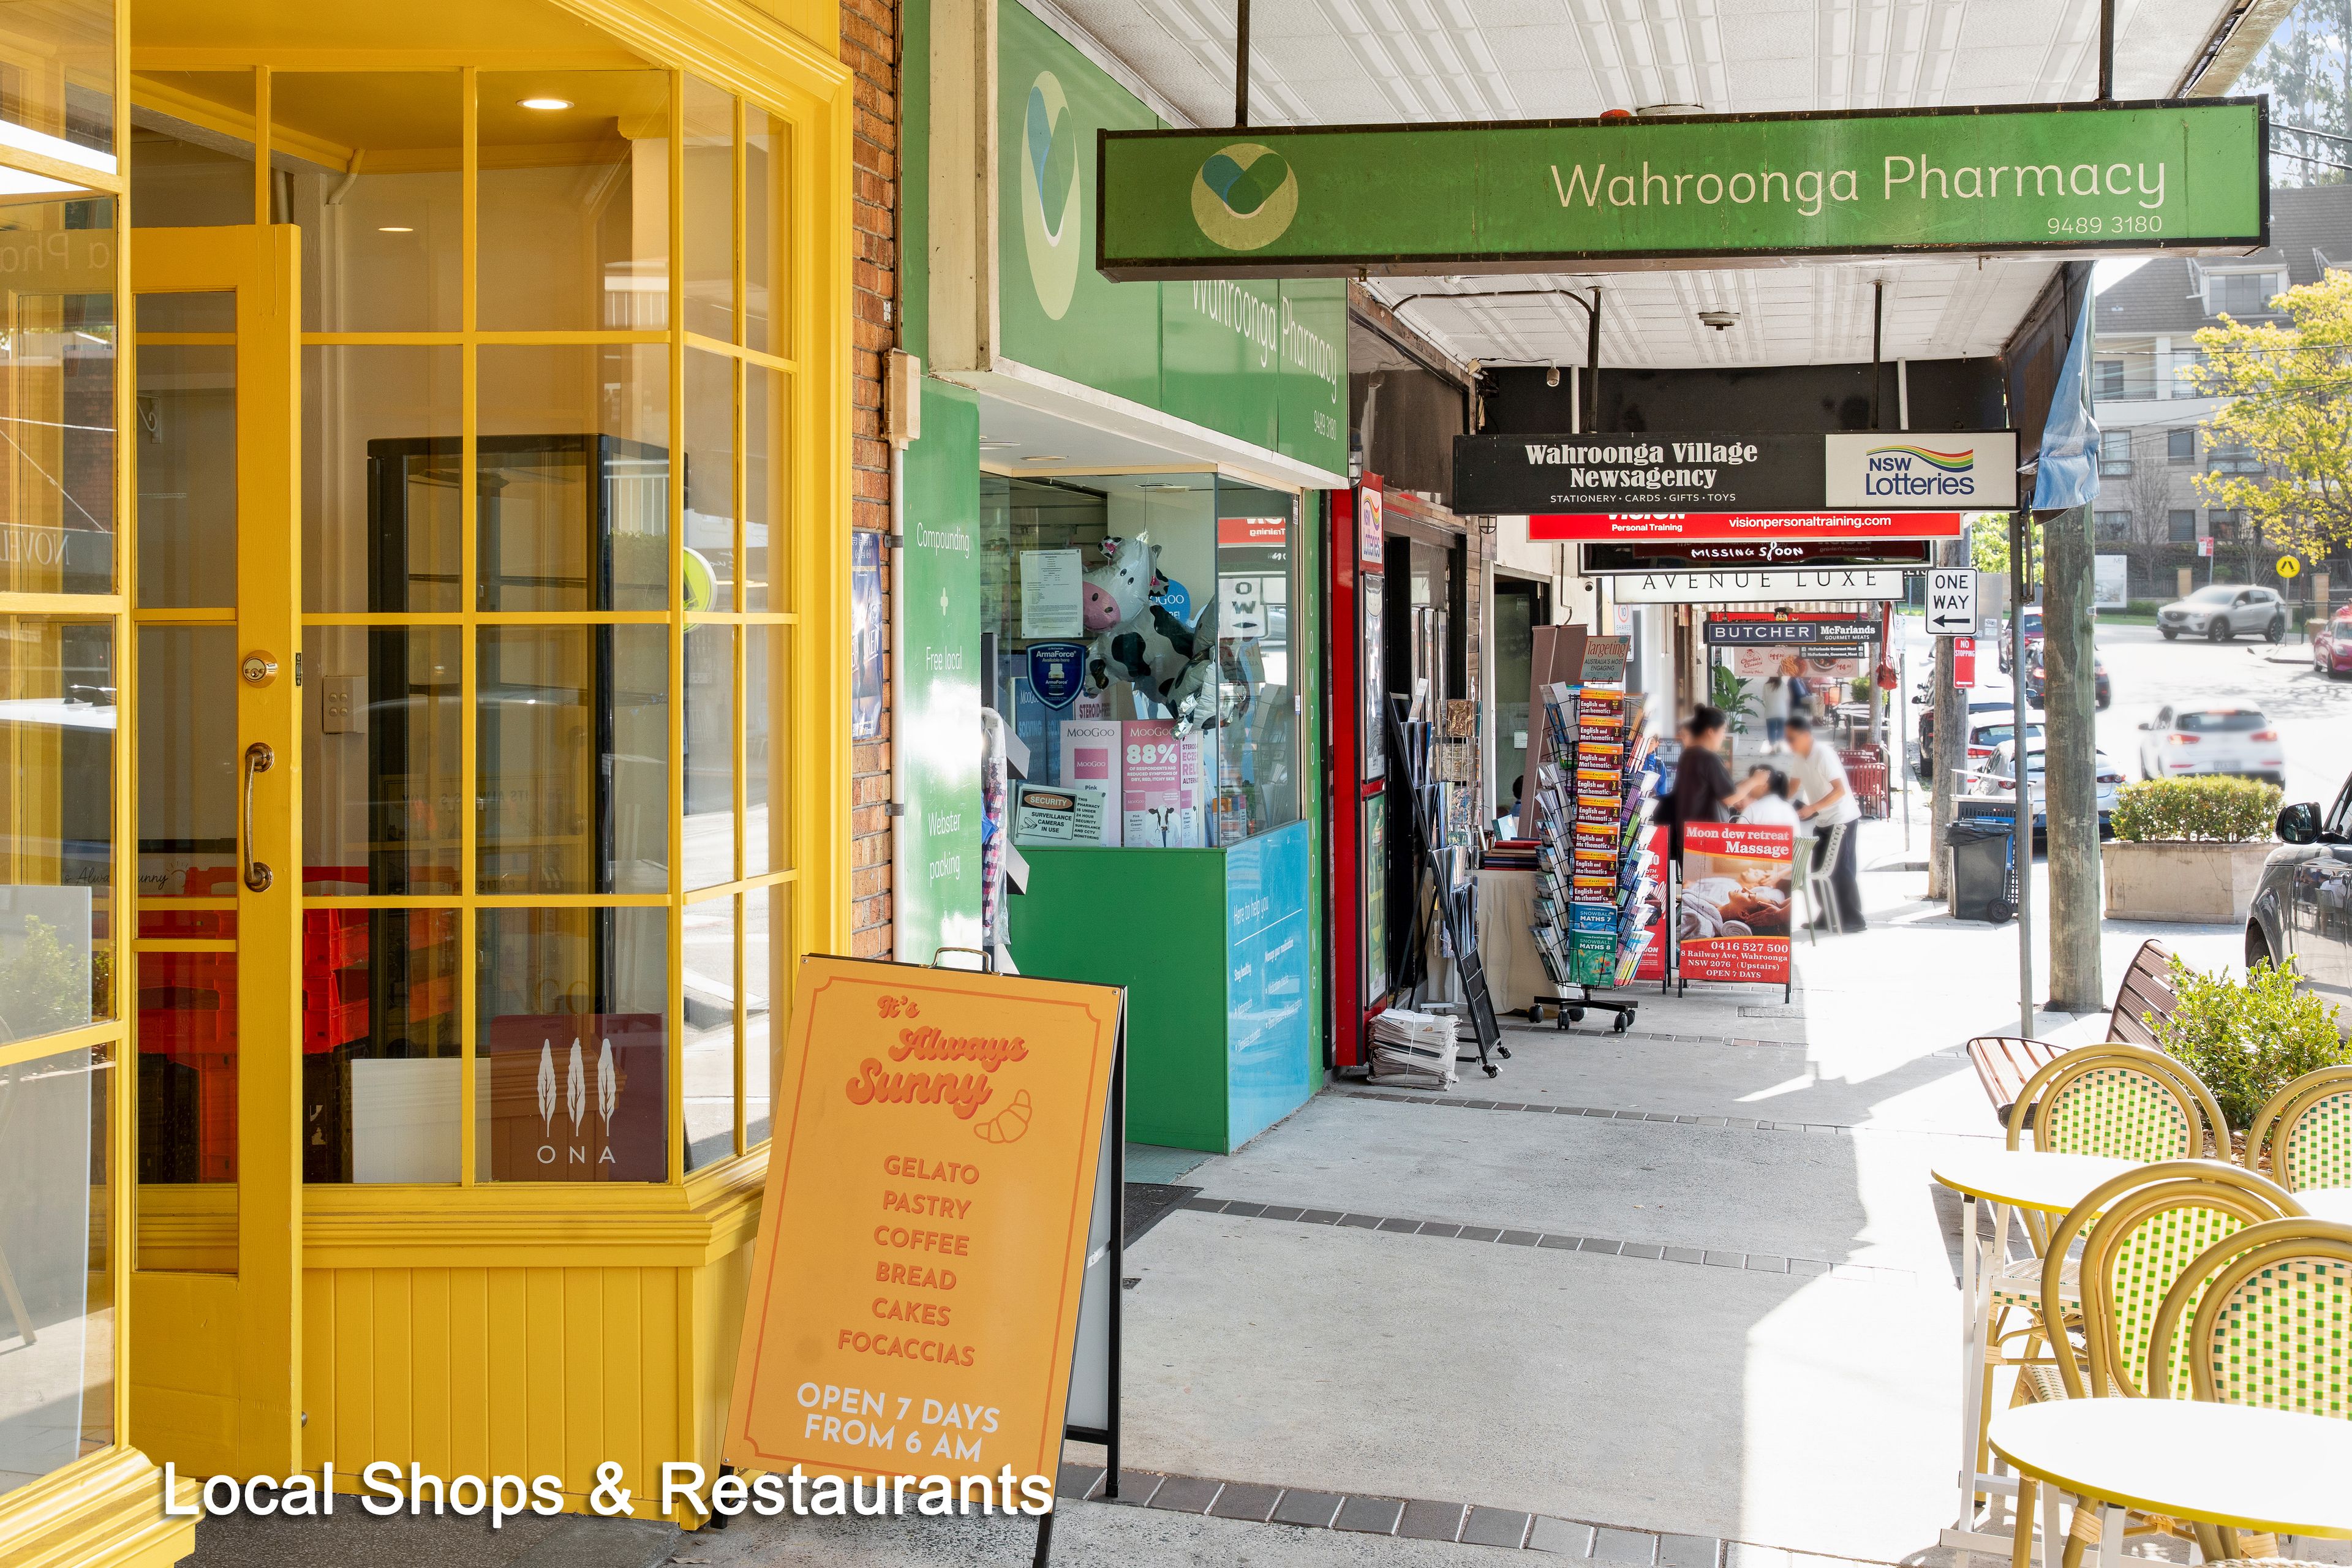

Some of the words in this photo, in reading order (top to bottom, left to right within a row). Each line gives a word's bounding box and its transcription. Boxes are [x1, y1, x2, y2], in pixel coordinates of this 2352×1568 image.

[1551, 162, 1858, 216] Wahroonga
[1884, 154, 2165, 209] Pharmacy
[2047, 217, 2102, 235] 9489
[2112, 215, 2162, 233] 3180
[1283, 296, 1336, 404] Pharmacy
[1314, 410, 1325, 435] 9489
[1327, 416, 1336, 440] 3180
[1525, 443, 1664, 466] Wahroonga
[1672, 442, 1757, 465] Village
[1869, 458, 1912, 471] NSW
[1570, 467, 1717, 489] Newsagency
[1866, 473, 1975, 495] Lotteries
[1707, 493, 1736, 502] TOYS
[1650, 524, 1683, 532] Training
[1729, 516, 1891, 529] visionpersonaltraining.com
[917, 522, 970, 559] Compounding
[1691, 548, 1754, 558] MISSING
[1643, 572, 1771, 590] AVENUE
[1796, 571, 1877, 588] LUXE
[1936, 575, 1969, 589] ONE
[1934, 595, 1969, 609] WAY
[1715, 627, 1809, 638] BUTCHER
[1820, 625, 1875, 635] McFarlands
[926, 646, 943, 671] Free
[945, 646, 962, 670] local
[1587, 641, 1626, 658] Targeting
[1030, 796, 1067, 806] SECURITY
[928, 809, 961, 837] Webster
[1031, 812, 1072, 821] SURVEILLANCE
[1686, 827, 1719, 839] Moon
[1721, 828, 1746, 839] dew
[1747, 831, 1789, 840] retreat
[1725, 841, 1789, 858] Massage
[930, 851, 960, 888] packing
[1234, 904, 1244, 926] Here
[1245, 902, 1250, 921] to
[1251, 895, 1260, 922] help
[1265, 949, 1275, 963] Manage
[1711, 941, 1740, 951] 0416
[1743, 943, 1764, 952] 527
[1767, 944, 1788, 953] 500
[1241, 962, 1251, 978] healthy
[1736, 961, 1779, 971] (Upstairs)
[877, 995, 920, 1018] It's
[888, 1025, 1029, 1072] Always
[846, 1057, 993, 1119] Sunny
[537, 1145, 616, 1164] ONA
[884, 1155, 979, 1185] GELATO
[883, 1190, 972, 1219] PASTRY
[873, 1225, 970, 1256] COFFEE
[875, 1261, 957, 1290] BREAD
[872, 1297, 951, 1327] CAKES
[838, 1329, 975, 1366] FOCACCIAS
[797, 1382, 885, 1418] OPEN
[896, 1397, 912, 1420] 7
[922, 1398, 1000, 1433] DAYS
[805, 1414, 895, 1450] FROM
[905, 1431, 922, 1453] 6
[931, 1431, 982, 1463] AM
